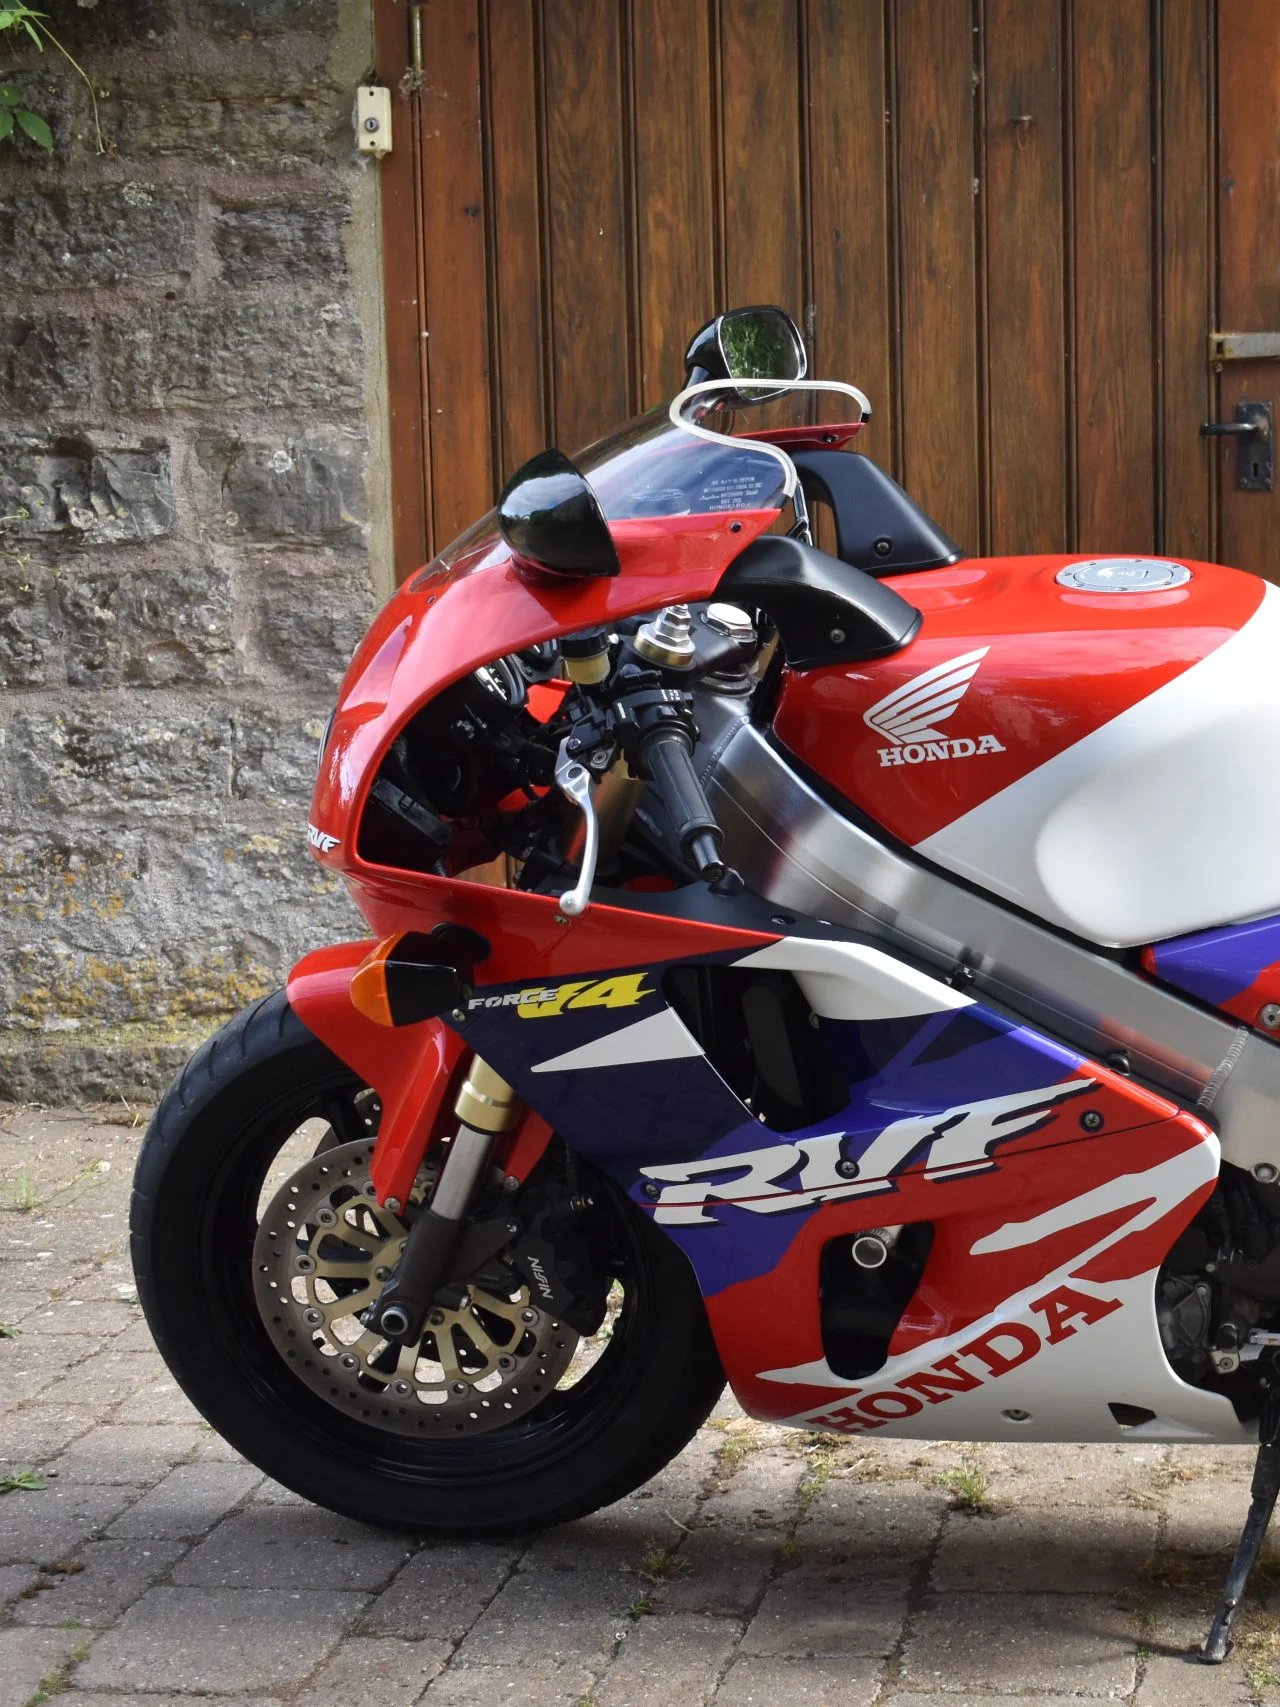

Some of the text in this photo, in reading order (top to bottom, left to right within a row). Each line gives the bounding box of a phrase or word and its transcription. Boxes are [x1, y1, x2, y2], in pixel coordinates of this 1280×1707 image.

[876, 734, 1007, 768] HONDA
[468, 988, 562, 1010] FORCE
[517, 972, 657, 1019] V4
[639, 1077, 1098, 1226] RVF
[805, 1285, 1124, 1433] HONDA
